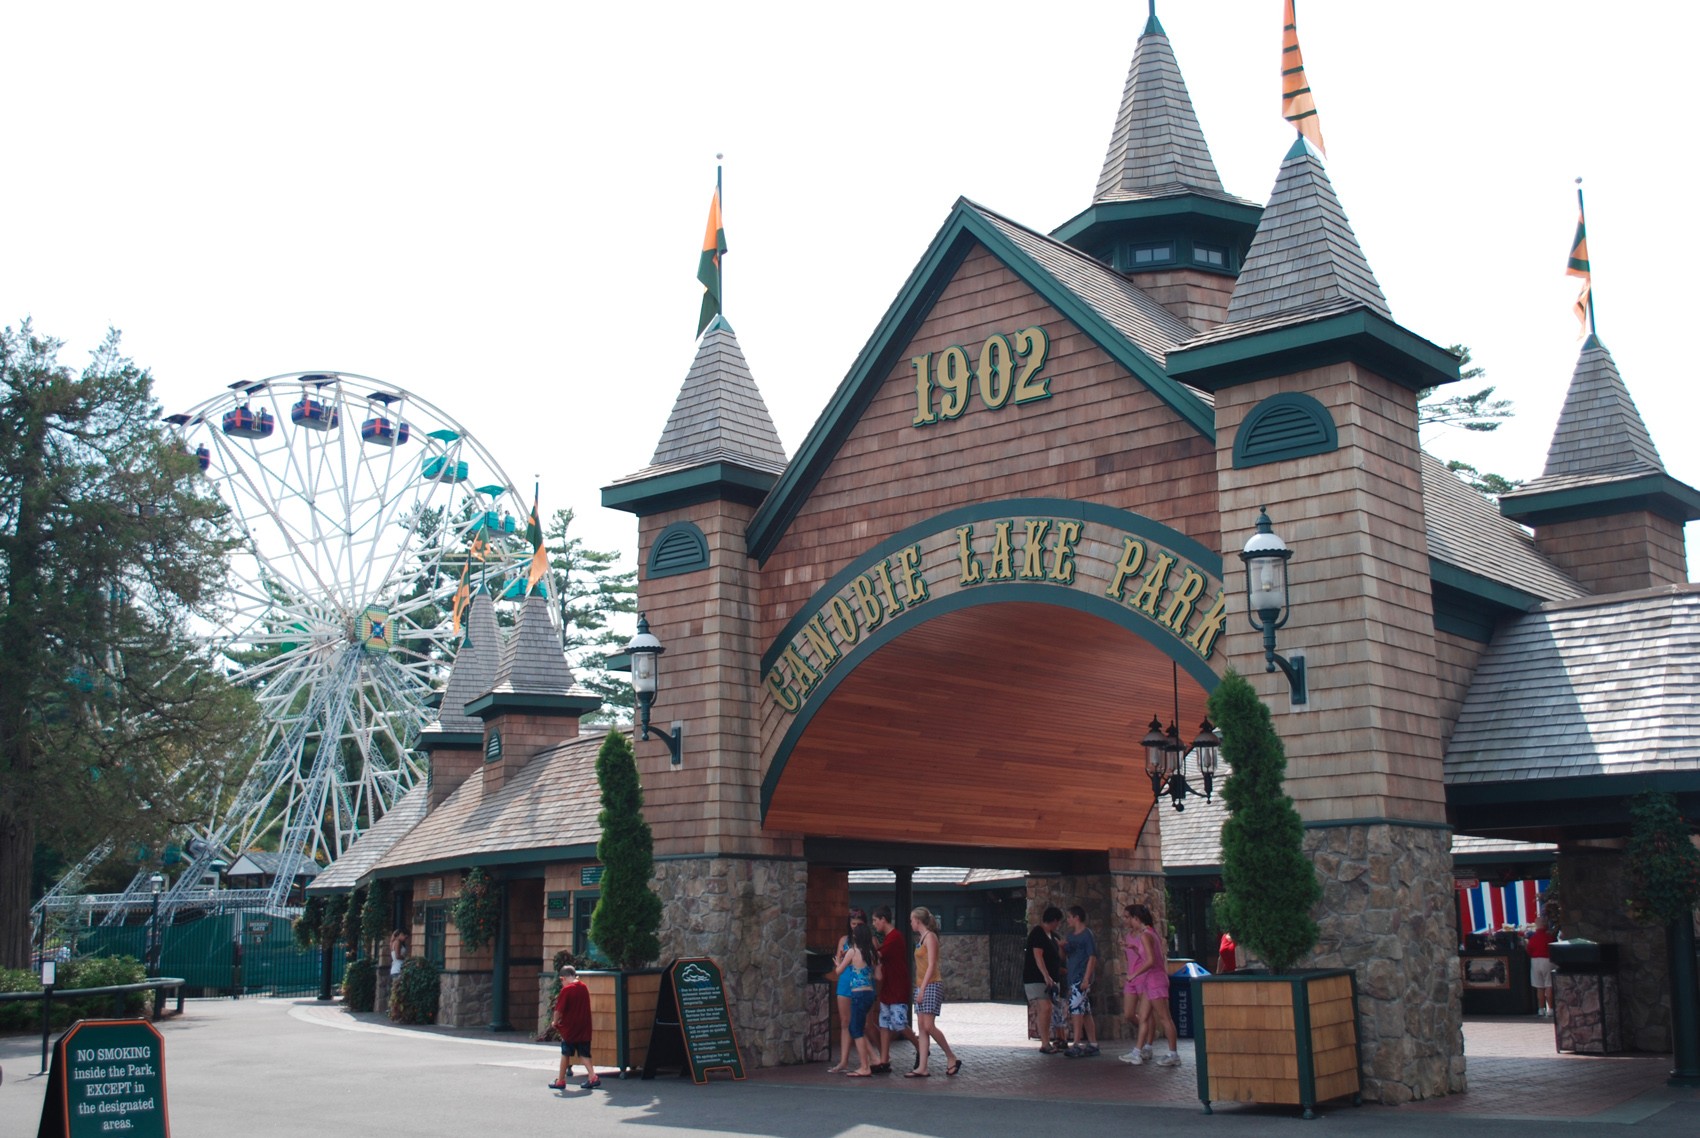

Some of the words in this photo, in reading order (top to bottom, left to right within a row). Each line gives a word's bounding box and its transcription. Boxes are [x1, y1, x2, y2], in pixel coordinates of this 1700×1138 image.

[912, 325, 1052, 428] 1902
[765, 544, 930, 713] CANOBIE
[956, 519, 1084, 587] LAKE
[1105, 535, 1227, 660] PARK
[1179, 991, 1187, 1036] RECYCLE
[77, 1049, 95, 1062] NO
[97, 1046, 151, 1060] SMOKING
[74, 1066, 106, 1079] inside
[109, 1065, 125, 1077] the
[127, 1063, 156, 1077] Park,
[86, 1081, 132, 1096] EXCEPT
[134, 1081, 145, 1093] in
[79, 1102, 96, 1114] the
[98, 1097, 155, 1114] designated
[103, 1118, 134, 1131] areas.
